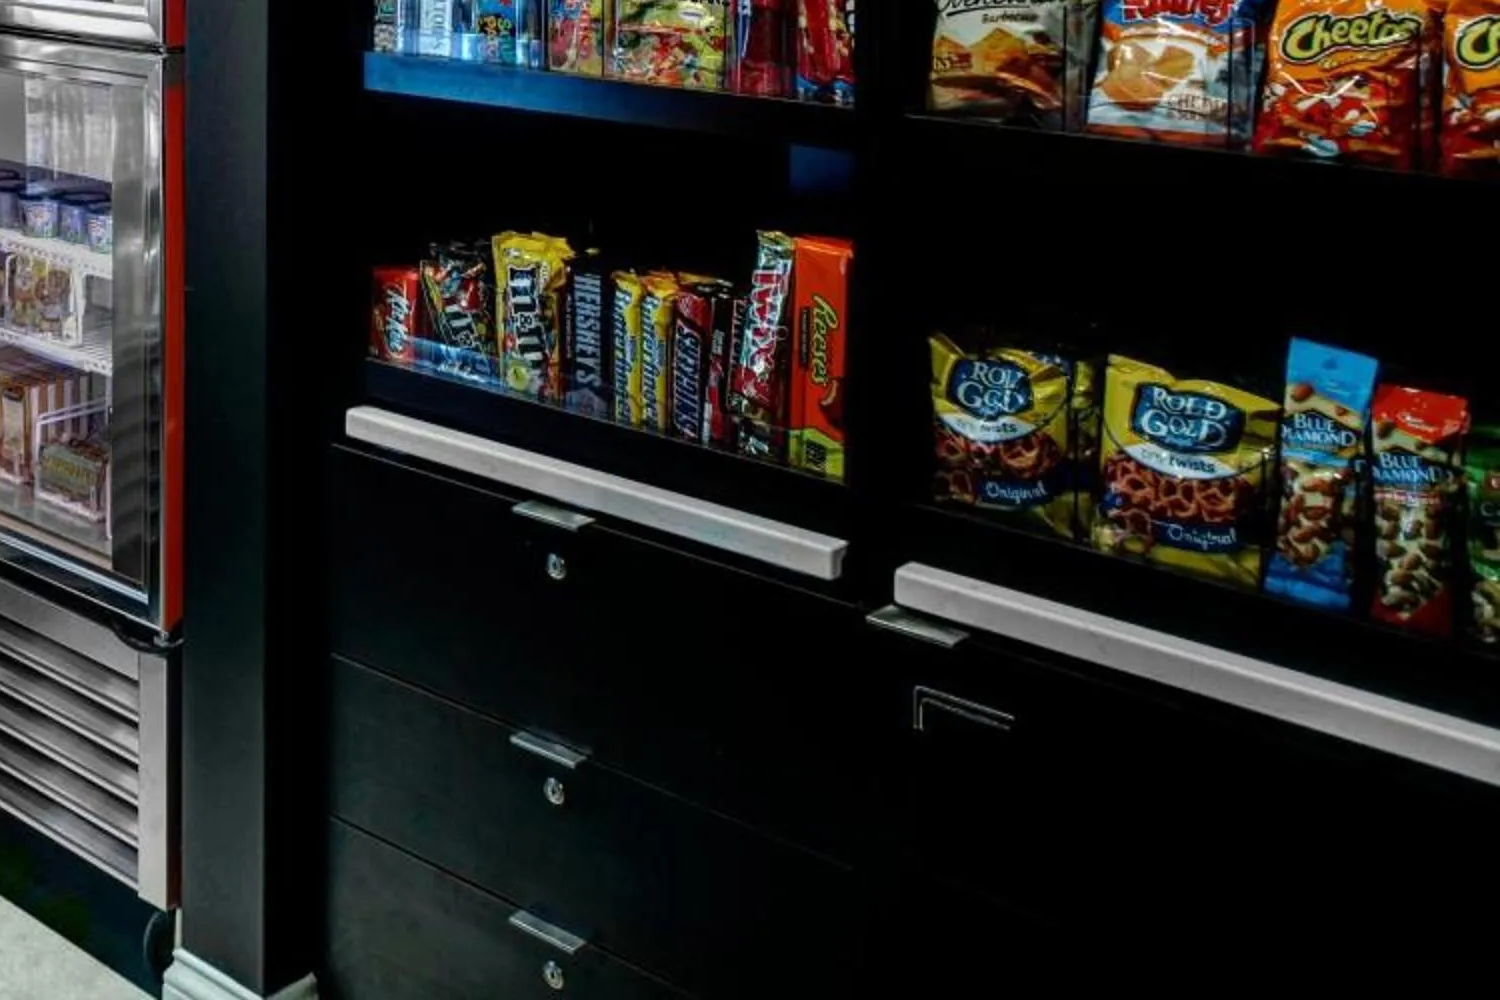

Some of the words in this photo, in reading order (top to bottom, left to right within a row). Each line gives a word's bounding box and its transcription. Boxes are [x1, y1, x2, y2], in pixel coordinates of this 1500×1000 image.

[1281, 9, 1422, 62] Cheetos
[574, 274, 602, 387] HERSHEY'S
[810, 294, 841, 387] Reese's
[675, 325, 700, 440] SNICKERS
[1140, 408, 1229, 448] GOLD
[1293, 412, 1340, 433] BLUE
[984, 479, 1049, 504] Original
[1166, 522, 1238, 551] Original
